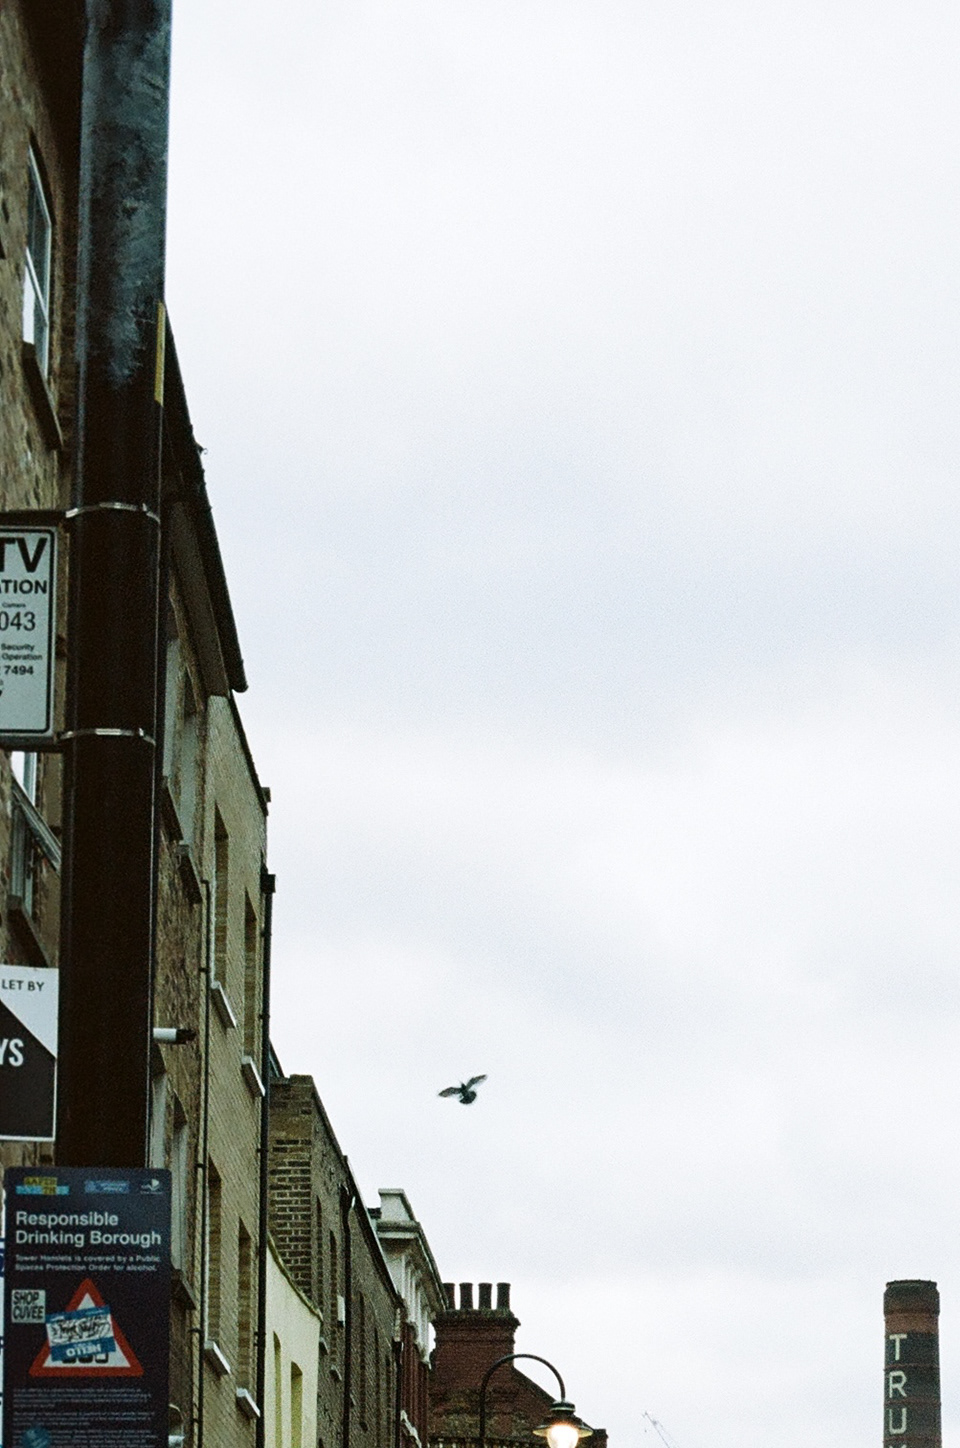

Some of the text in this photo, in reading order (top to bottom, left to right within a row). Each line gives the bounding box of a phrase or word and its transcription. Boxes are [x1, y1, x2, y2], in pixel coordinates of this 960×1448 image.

[0, 579, 48, 595] TION
[4, 665, 34, 675] 7494
[2, 979, 45, 992] LET BY
[16, 1211, 119, 1228] Responsible
[16, 1230, 162, 1248] Drinking Borough
